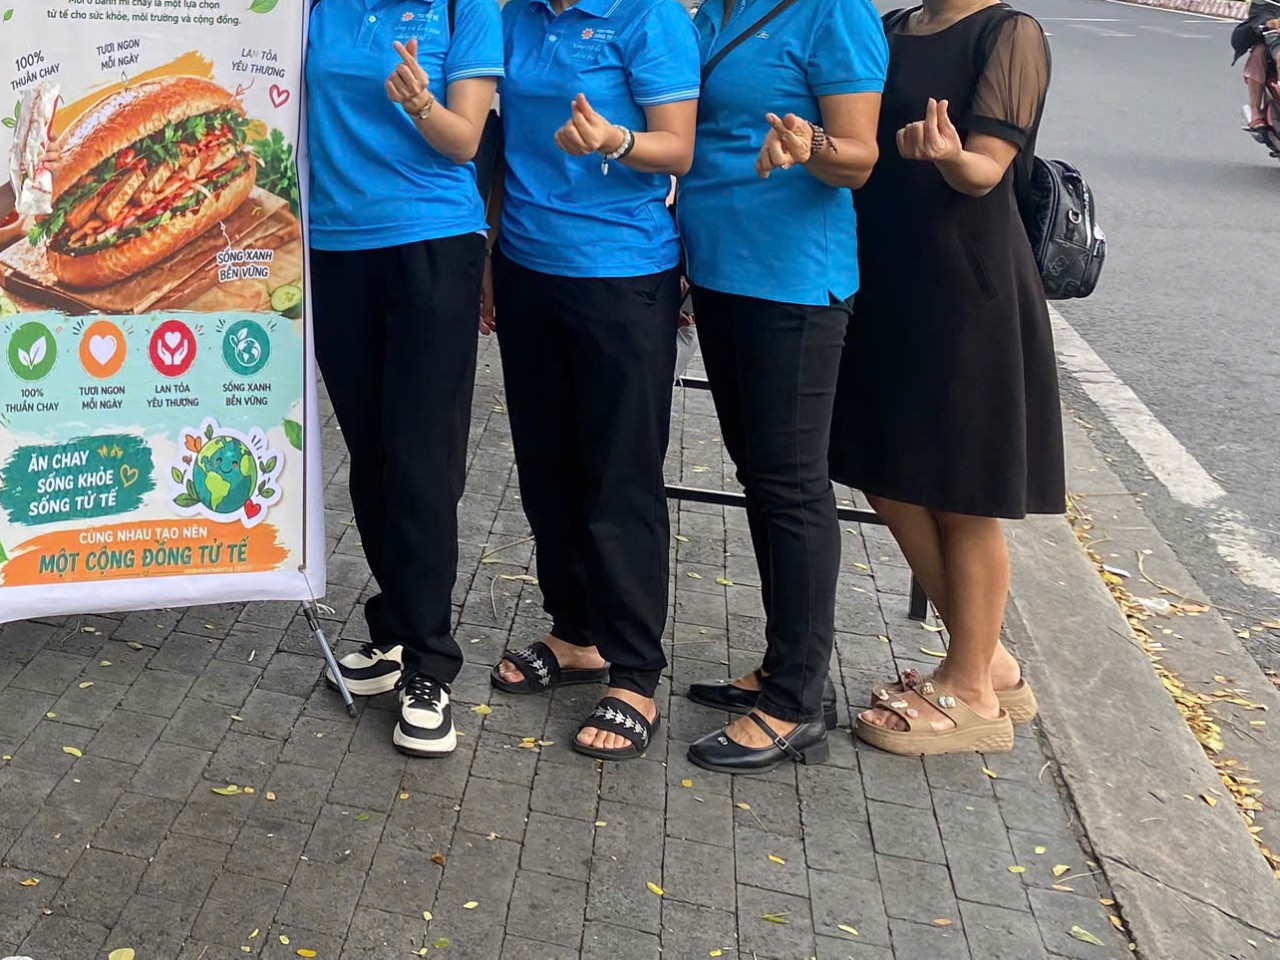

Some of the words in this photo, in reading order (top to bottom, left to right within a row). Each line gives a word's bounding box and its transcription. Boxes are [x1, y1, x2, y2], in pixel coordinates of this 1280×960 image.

[199, 0, 220, 10] chọn
[59, 8, 69, 19] tế
[71, 10, 86, 19] cho
[89, 10, 104, 20] sức
[132, 12, 148, 21] môi
[150, 12, 178, 24] trường
[181, 13, 191, 23] và
[194, 14, 214, 26] cộng
[96, 42, 115, 56] TƯƠI
[117, 39, 140, 52] NGON
[261, 49, 278, 62] TỎA
[16, 50, 45, 71] 100%
[101, 55, 116, 70] MỖI
[118, 52, 140, 66] NGÀY
[10, 71, 37, 90] THUẦN
[40, 63, 60, 78] CHAY
[232, 60, 248, 72] YÊU
[250, 64, 285, 78] THƯƠNG
[217, 248, 243, 264] SỐNG
[246, 251, 272, 261] XANH
[242, 265, 268, 278] VỮNG
[21, 388, 44, 397] 100%
[79, 386, 98, 395] TƯƠI
[101, 386, 125, 395] NGON
[155, 385, 171, 393] LAN
[174, 382, 190, 393] TỎA
[223, 381, 245, 392] SỐNG
[247, 383, 271, 391] XANH
[36, 402, 59, 412] CHAY
[82, 398, 97, 410] MỖI
[100, 399, 123, 409] NGÀY
[147, 397, 163, 408] YÊU
[165, 398, 199, 407] THƯƠNG
[244, 395, 268, 405] VỮNG
[28, 453, 48, 472] ĂN
[52, 450, 89, 469] CHAY
[37, 472, 74, 494] SỐNG
[78, 466, 114, 488] KHỎE
[29, 495, 70, 516] SỐNG
[75, 490, 96, 510] TỬ
[100, 487, 118, 507] TẾ
[79, 530, 113, 544] CÙNG
[117, 529, 151, 541] NHAU
[156, 528, 179, 542] TẠO
[183, 526, 207, 539] NÊN
[39, 548, 80, 578] MỘT
[85, 545, 135, 576] CỘNG
[141, 539, 192, 567] ĐỒNG
[199, 538, 223, 565] TỬ
[227, 536, 249, 563] TẾ
